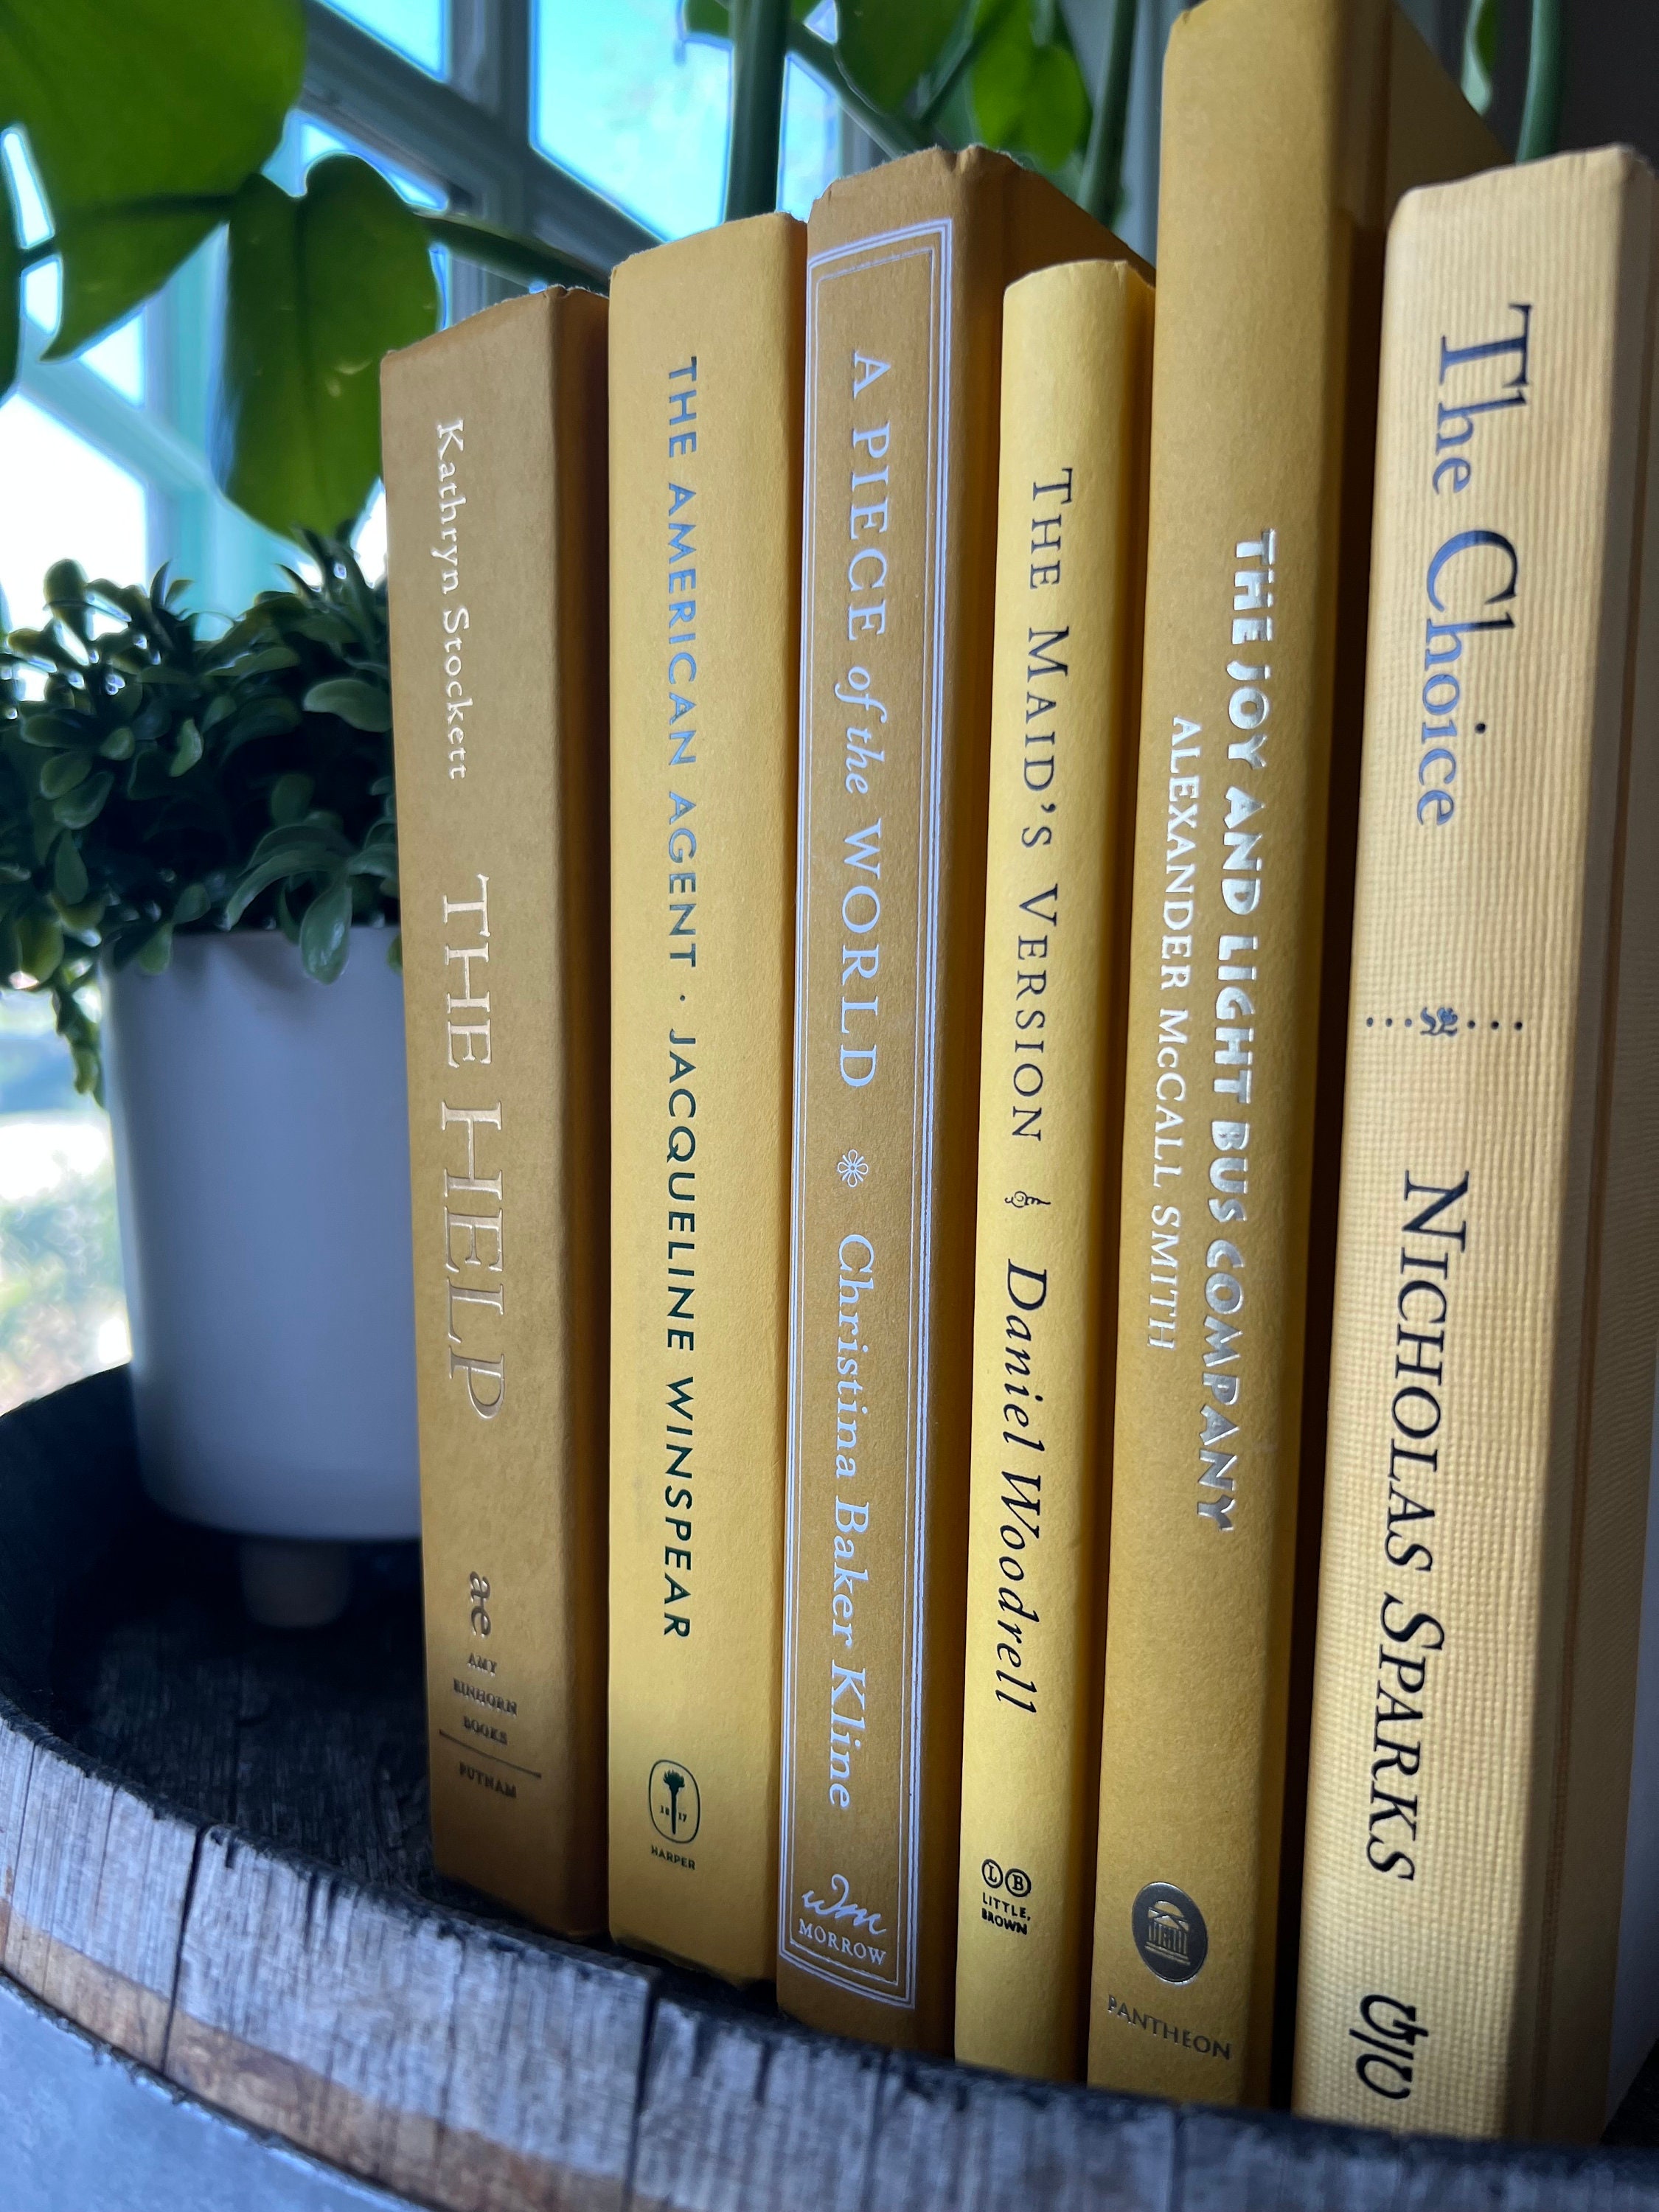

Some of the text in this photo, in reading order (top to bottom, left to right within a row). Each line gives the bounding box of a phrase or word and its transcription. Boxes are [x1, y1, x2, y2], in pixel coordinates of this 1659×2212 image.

[431, 418, 474, 780] Kathryn Stockett
[668, 355, 697, 967] THE AMERICAN AGENT
[1029, 467, 1073, 589] THE
[1416, 302, 1532, 827] The Choice
[834, 350, 891, 1087] A PIECE of the WORLD
[441, 874, 506, 1420] THE HELP
[1012, 883, 1058, 1141] VERSION
[1147, 715, 1201, 1349] ALEXANDER McCALL SMITH
[1197, 527, 1276, 1531] THE JOY AND LIGHT BUS COMPANY
[664, 1029, 696, 1638] JACQUELINE WINSPEAR
[995, 1258, 1047, 1714] Daniel Woodrell
[467, 1652, 498, 1676] AMY
[829, 1234, 875, 1809] Christina Baker Kline
[1366, 1169, 1470, 1882] NICHOLAS SPARKS
[459, 1761, 516, 1798] PUTNAM
[464, 1716, 508, 1746] BOOKS
[650, 1844, 696, 1870] HARPER
[982, 1891, 1032, 1919] LITTLE,
[799, 1918, 886, 1966] MORROW
[981, 1908, 1028, 1935] BROWN
[1107, 1994, 1232, 2061] PANTHEON
